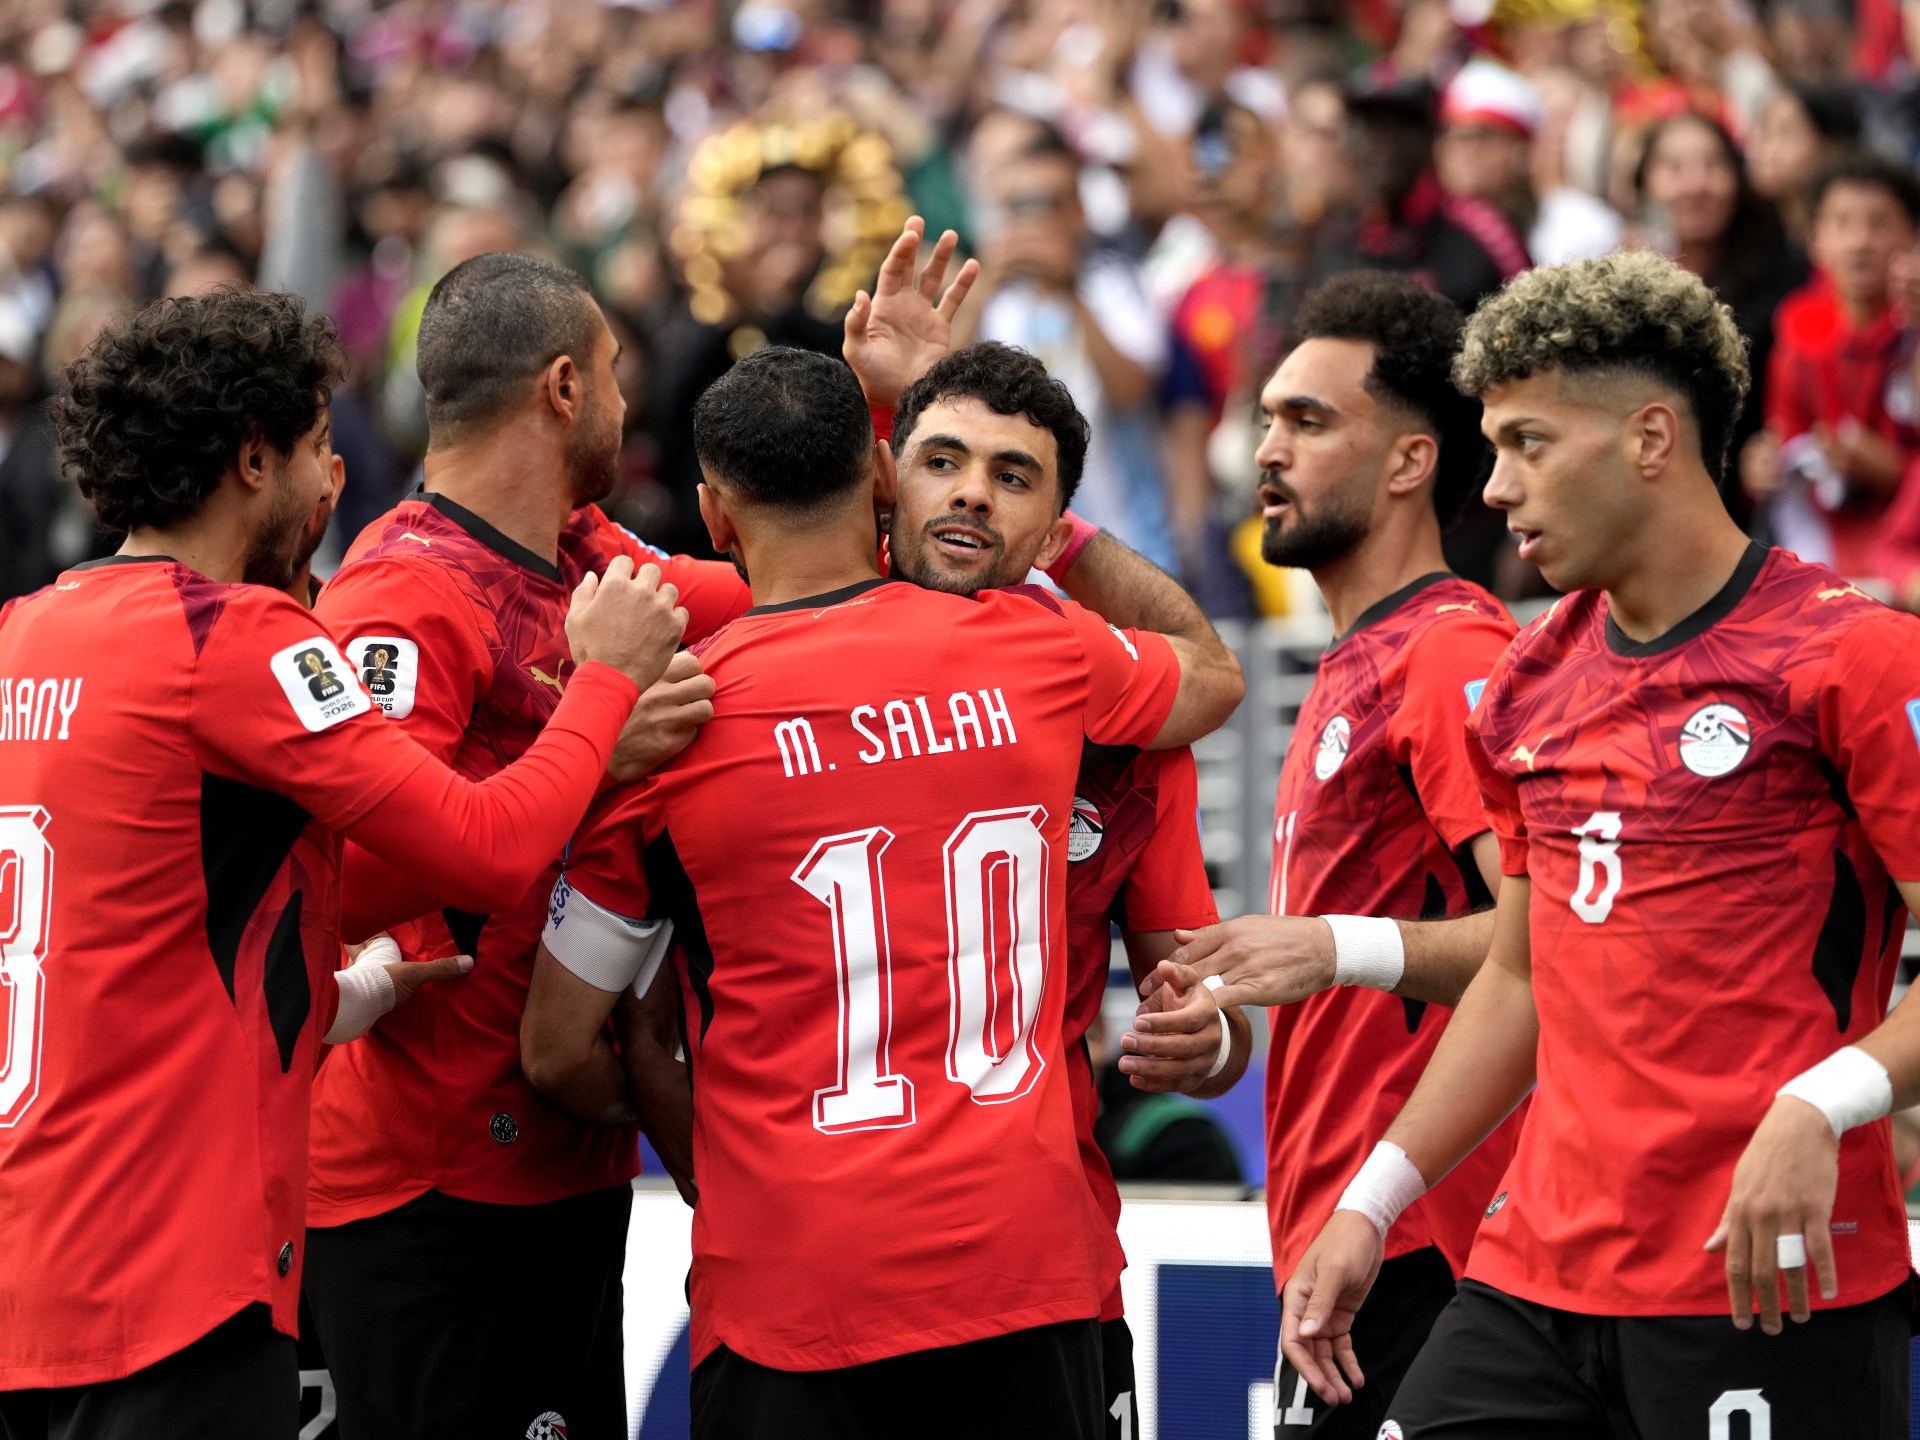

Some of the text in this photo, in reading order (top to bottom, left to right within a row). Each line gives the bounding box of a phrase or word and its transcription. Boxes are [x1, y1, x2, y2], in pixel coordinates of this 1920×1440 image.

[322, 685, 339, 697] FIFA
[369, 683, 386, 691] FIFA
[319, 698, 341, 712] WORLD
[323, 700, 356, 719] 2026
[773, 687, 1018, 778] M. SALAH
[790, 804, 1050, 1135] 10
